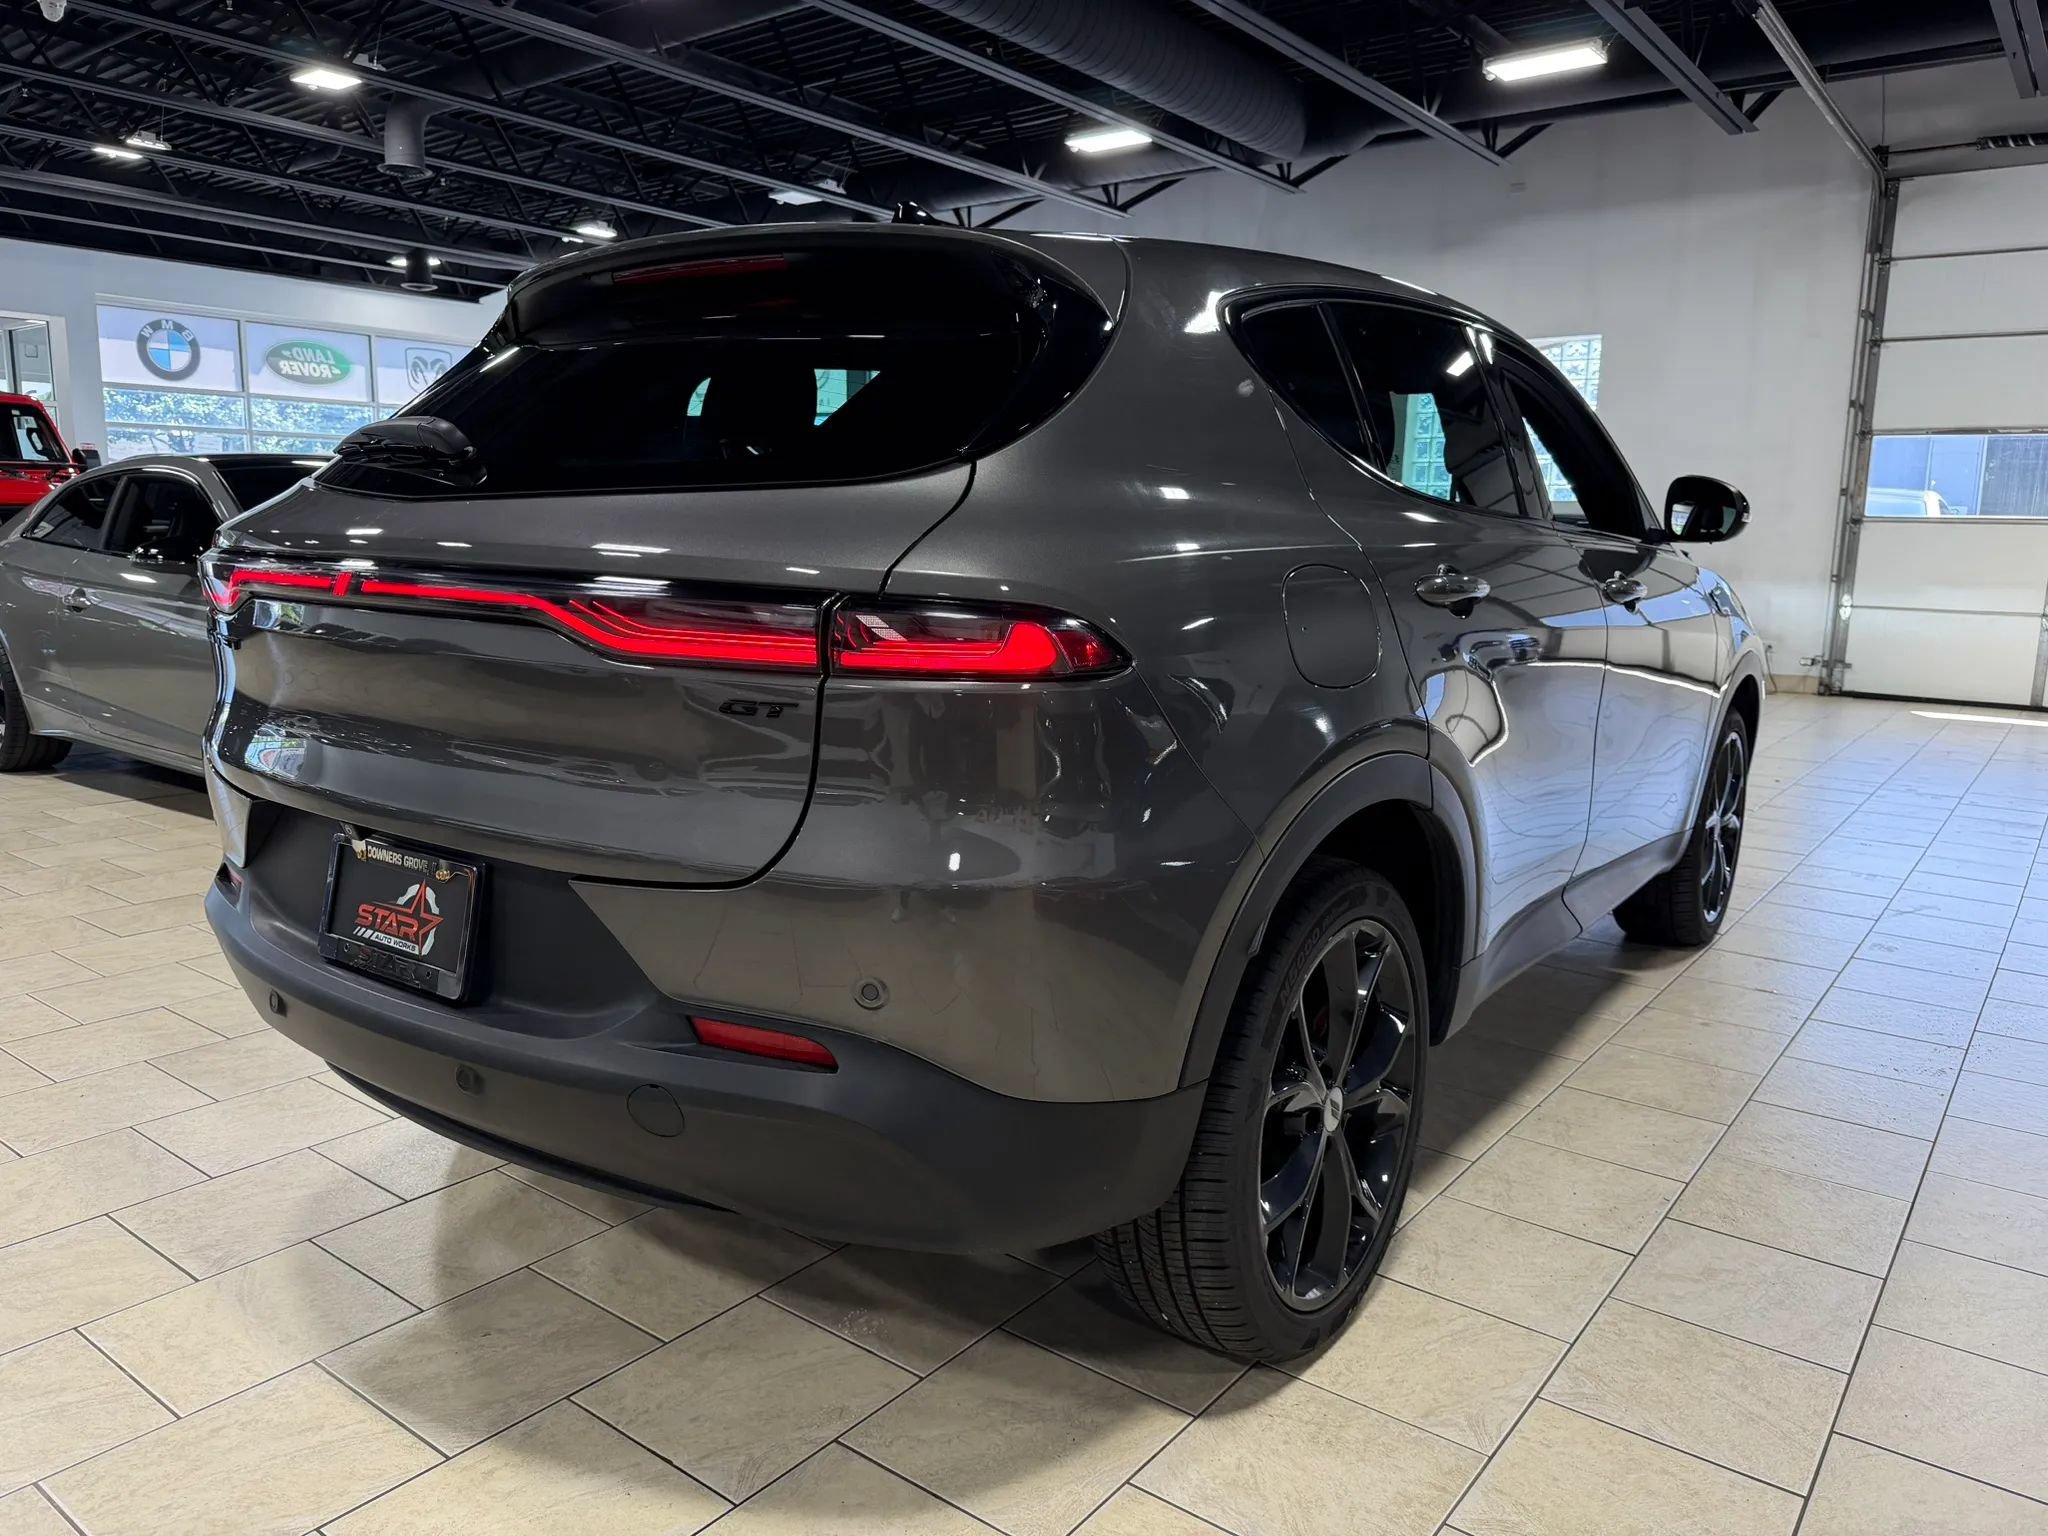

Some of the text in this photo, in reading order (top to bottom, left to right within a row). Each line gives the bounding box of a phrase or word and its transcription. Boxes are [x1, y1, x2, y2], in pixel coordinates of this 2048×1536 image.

[719, 700, 799, 718] GT
[367, 845, 402, 865] DOWNERS
[355, 904, 419, 941] STAR
[375, 934, 416, 952] AUTO WORKS
